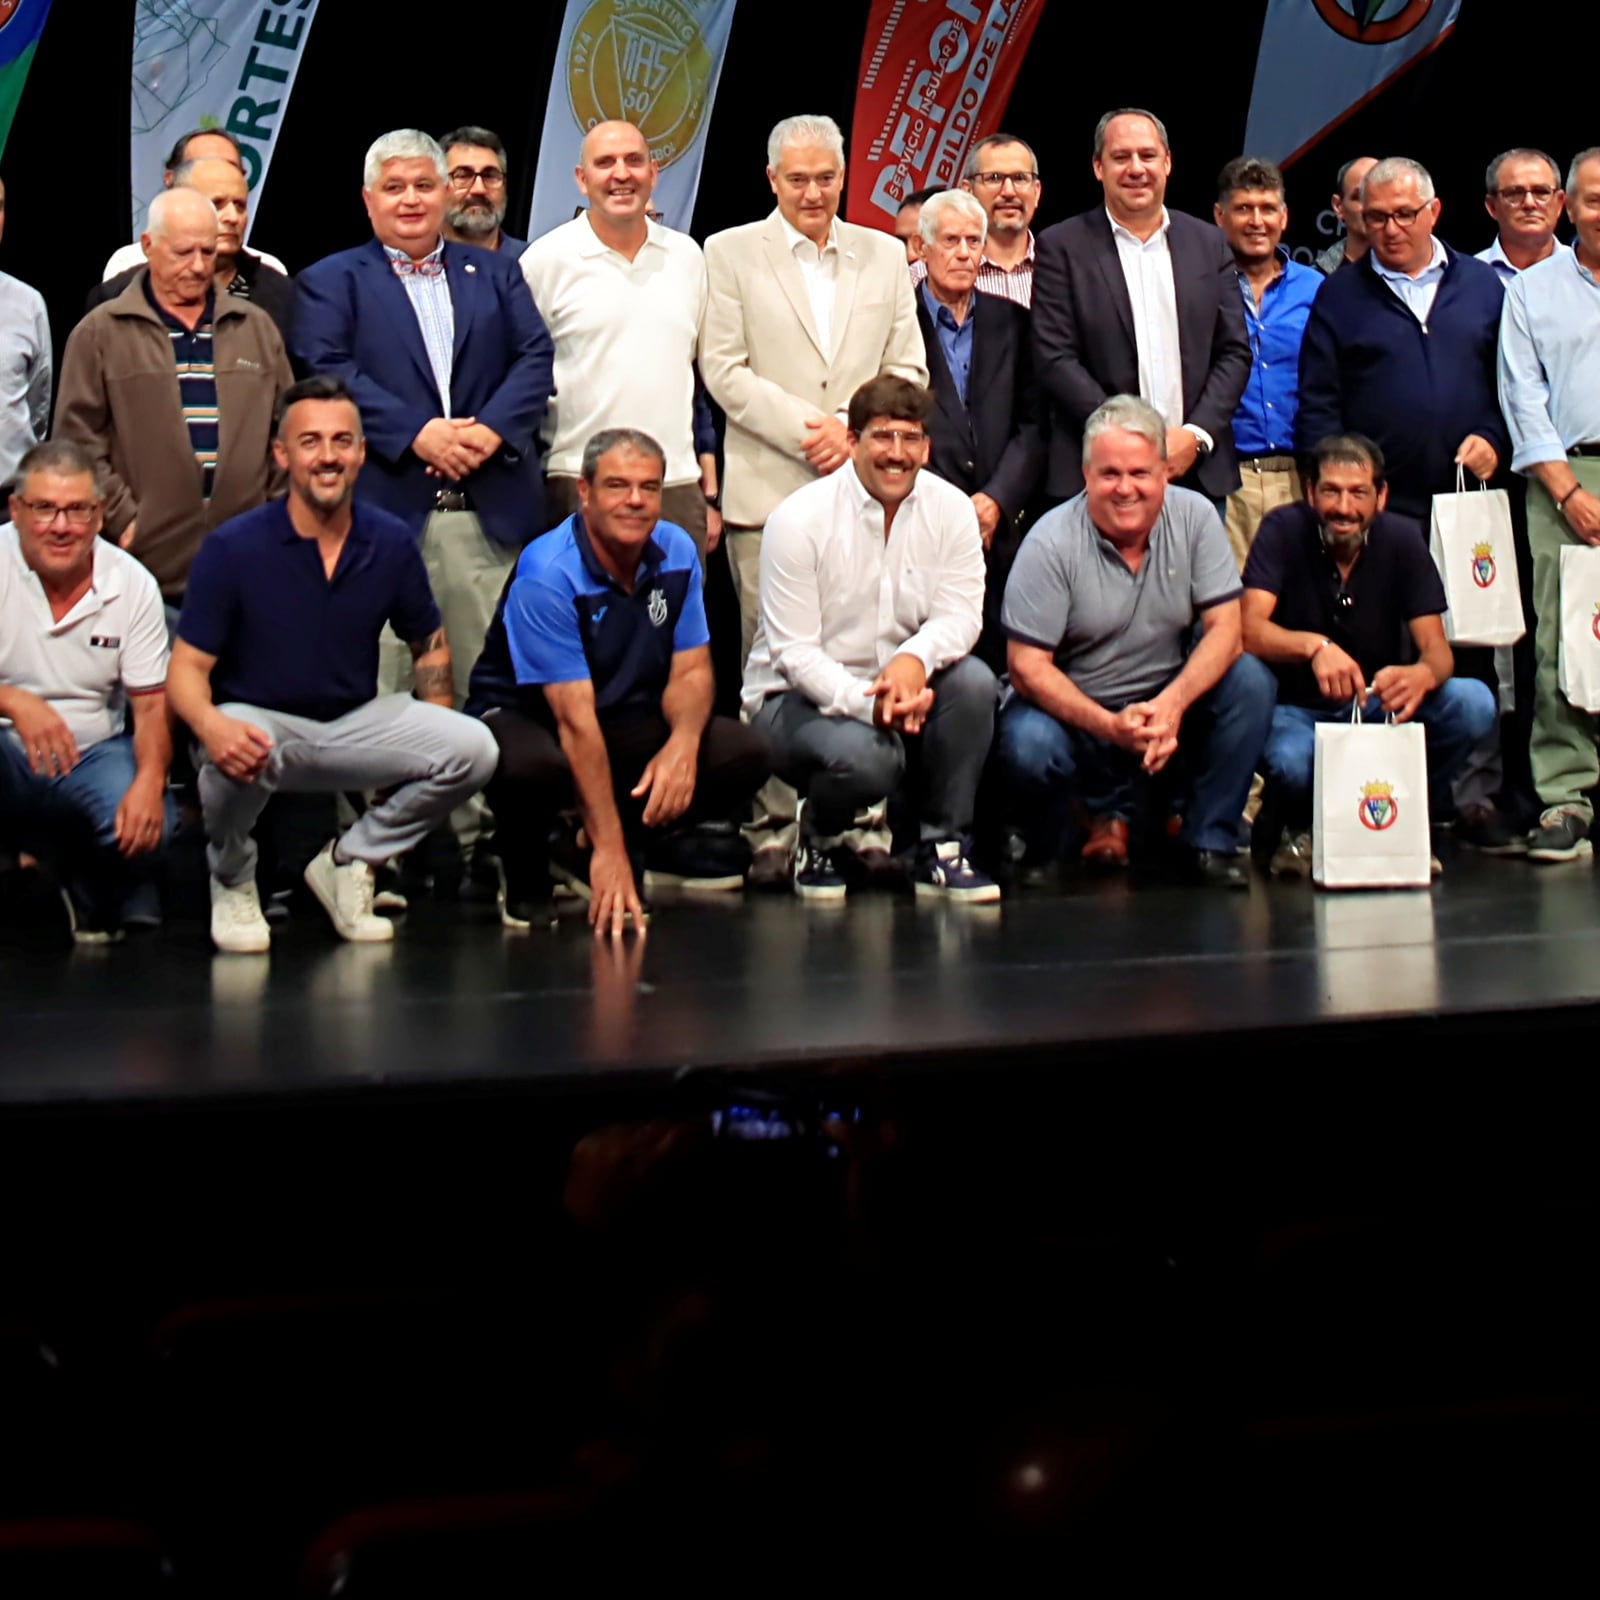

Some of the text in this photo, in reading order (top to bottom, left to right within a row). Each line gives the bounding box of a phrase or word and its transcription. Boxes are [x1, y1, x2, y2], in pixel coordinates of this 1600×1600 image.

[574, 31, 593, 74] 1974
[623, 87, 650, 112] 50
[889, 18, 963, 197] SERVICIO INSULAR DE
[936, 88, 979, 188] BILDO
[975, 38, 998, 82] DE
